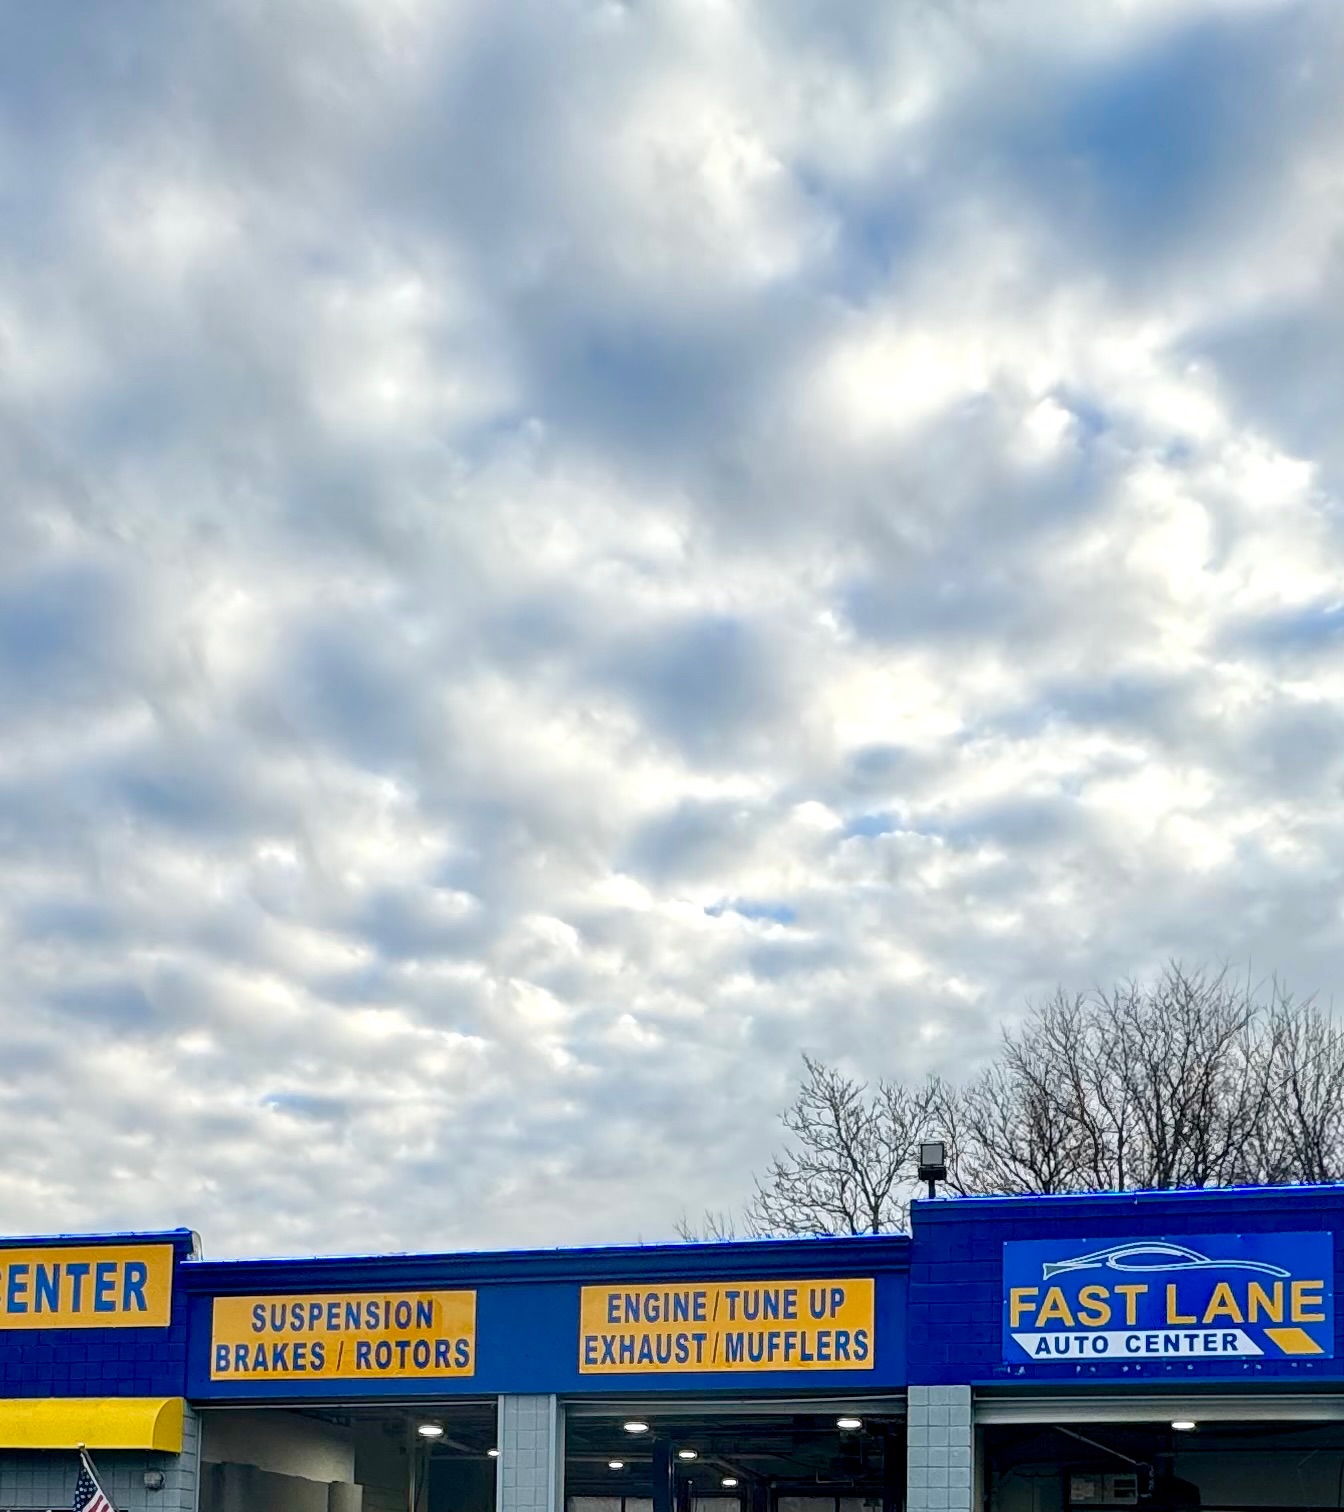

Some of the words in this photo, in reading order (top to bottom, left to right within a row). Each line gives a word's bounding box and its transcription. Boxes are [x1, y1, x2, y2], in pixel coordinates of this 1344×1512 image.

[251, 1300, 434, 1333] SUSPENSION
[808, 1287, 846, 1320] UP
[1008, 1283, 1149, 1329] FAST
[1165, 1278, 1327, 1326] LANE
[215, 1340, 326, 1373] BRAKES
[355, 1337, 471, 1370] ROTORS
[1034, 1333, 1111, 1356] AUTO
[1124, 1330, 1239, 1355] CENTER
